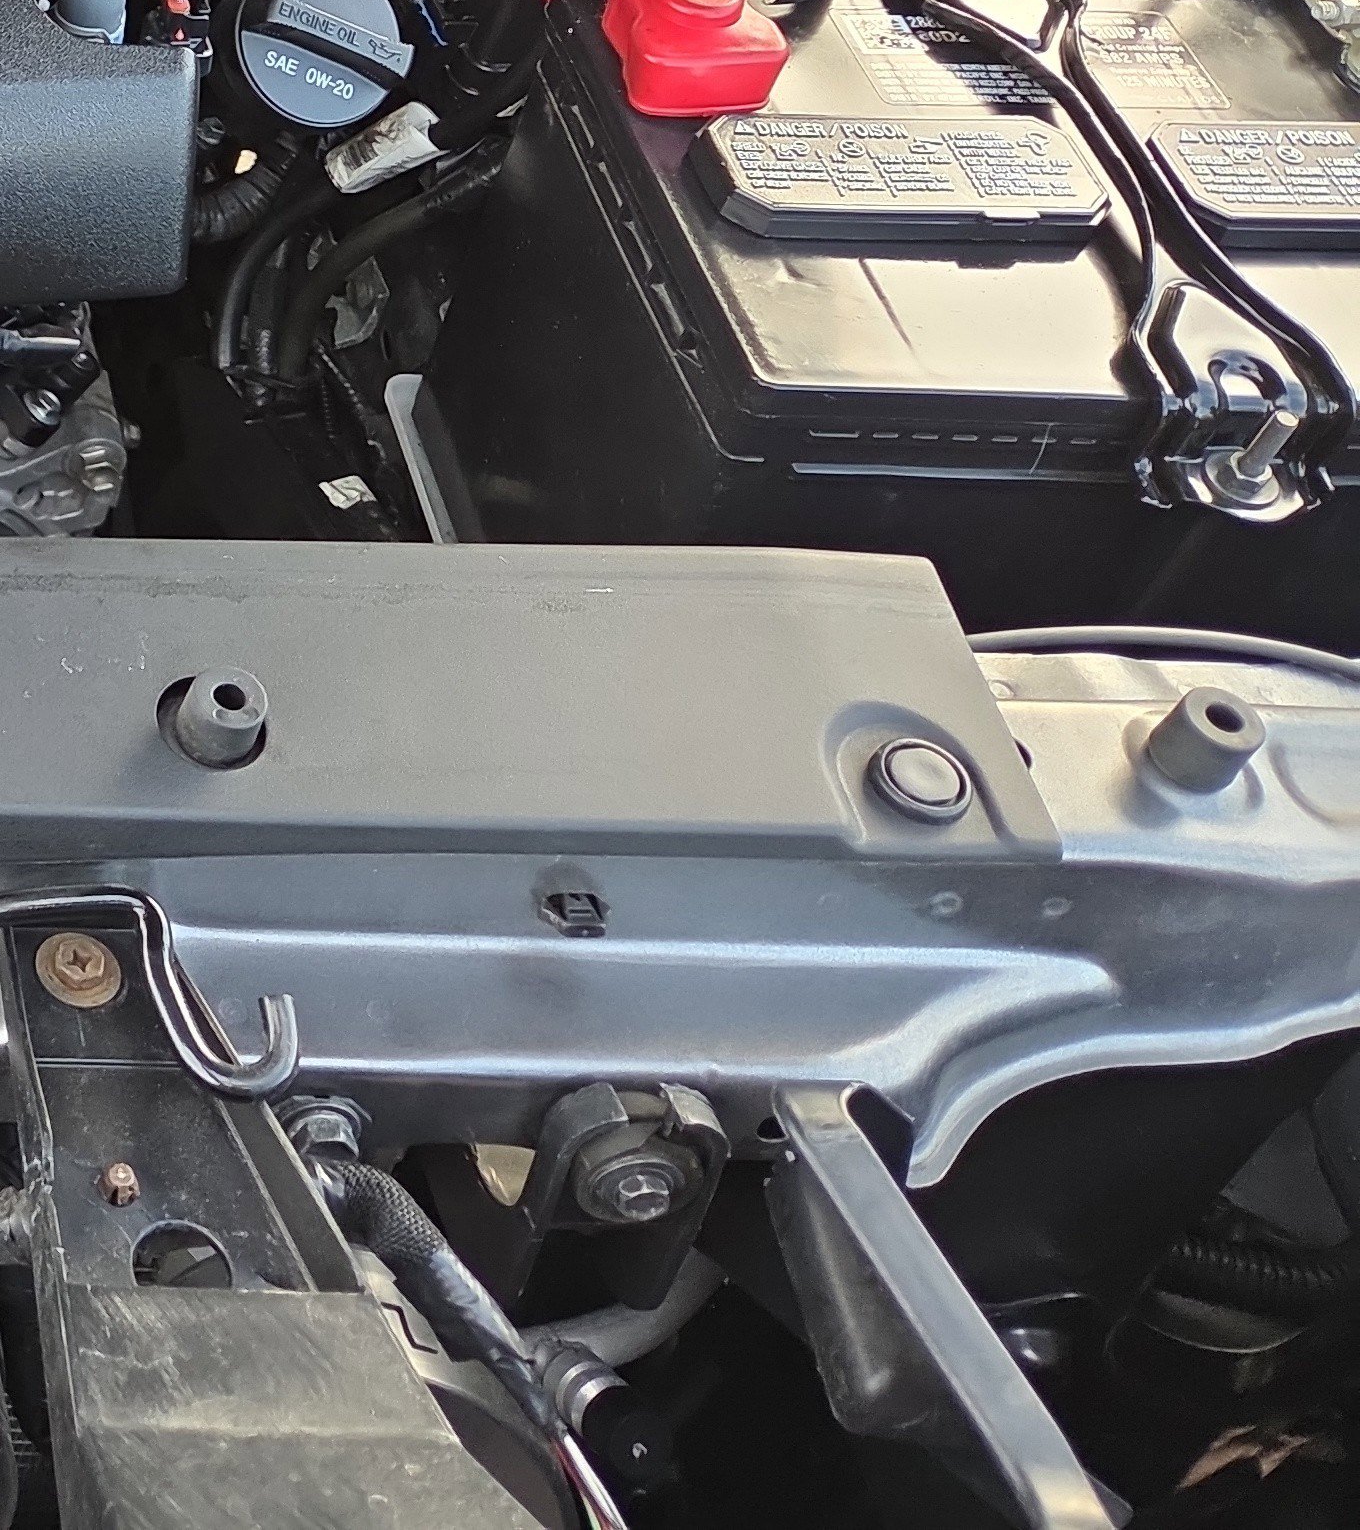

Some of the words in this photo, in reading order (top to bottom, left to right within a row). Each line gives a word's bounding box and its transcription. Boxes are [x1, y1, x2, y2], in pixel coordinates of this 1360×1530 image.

[278, 1, 337, 36] ENGINE
[336, 26, 361, 47] OIL
[1135, 52, 1185, 65] AMPS
[264, 50, 300, 76] SAE
[305, 67, 355, 100] 0W-20
[1146, 76, 1211, 89] MINUTES
[755, 121, 828, 137] DANGER
[829, 122, 839, 137] /
[840, 122, 909, 138] POISON
[1198, 129, 1274, 145] DANGER
[1274, 130, 1284, 145] /
[1285, 130, 1356, 145] POISON
